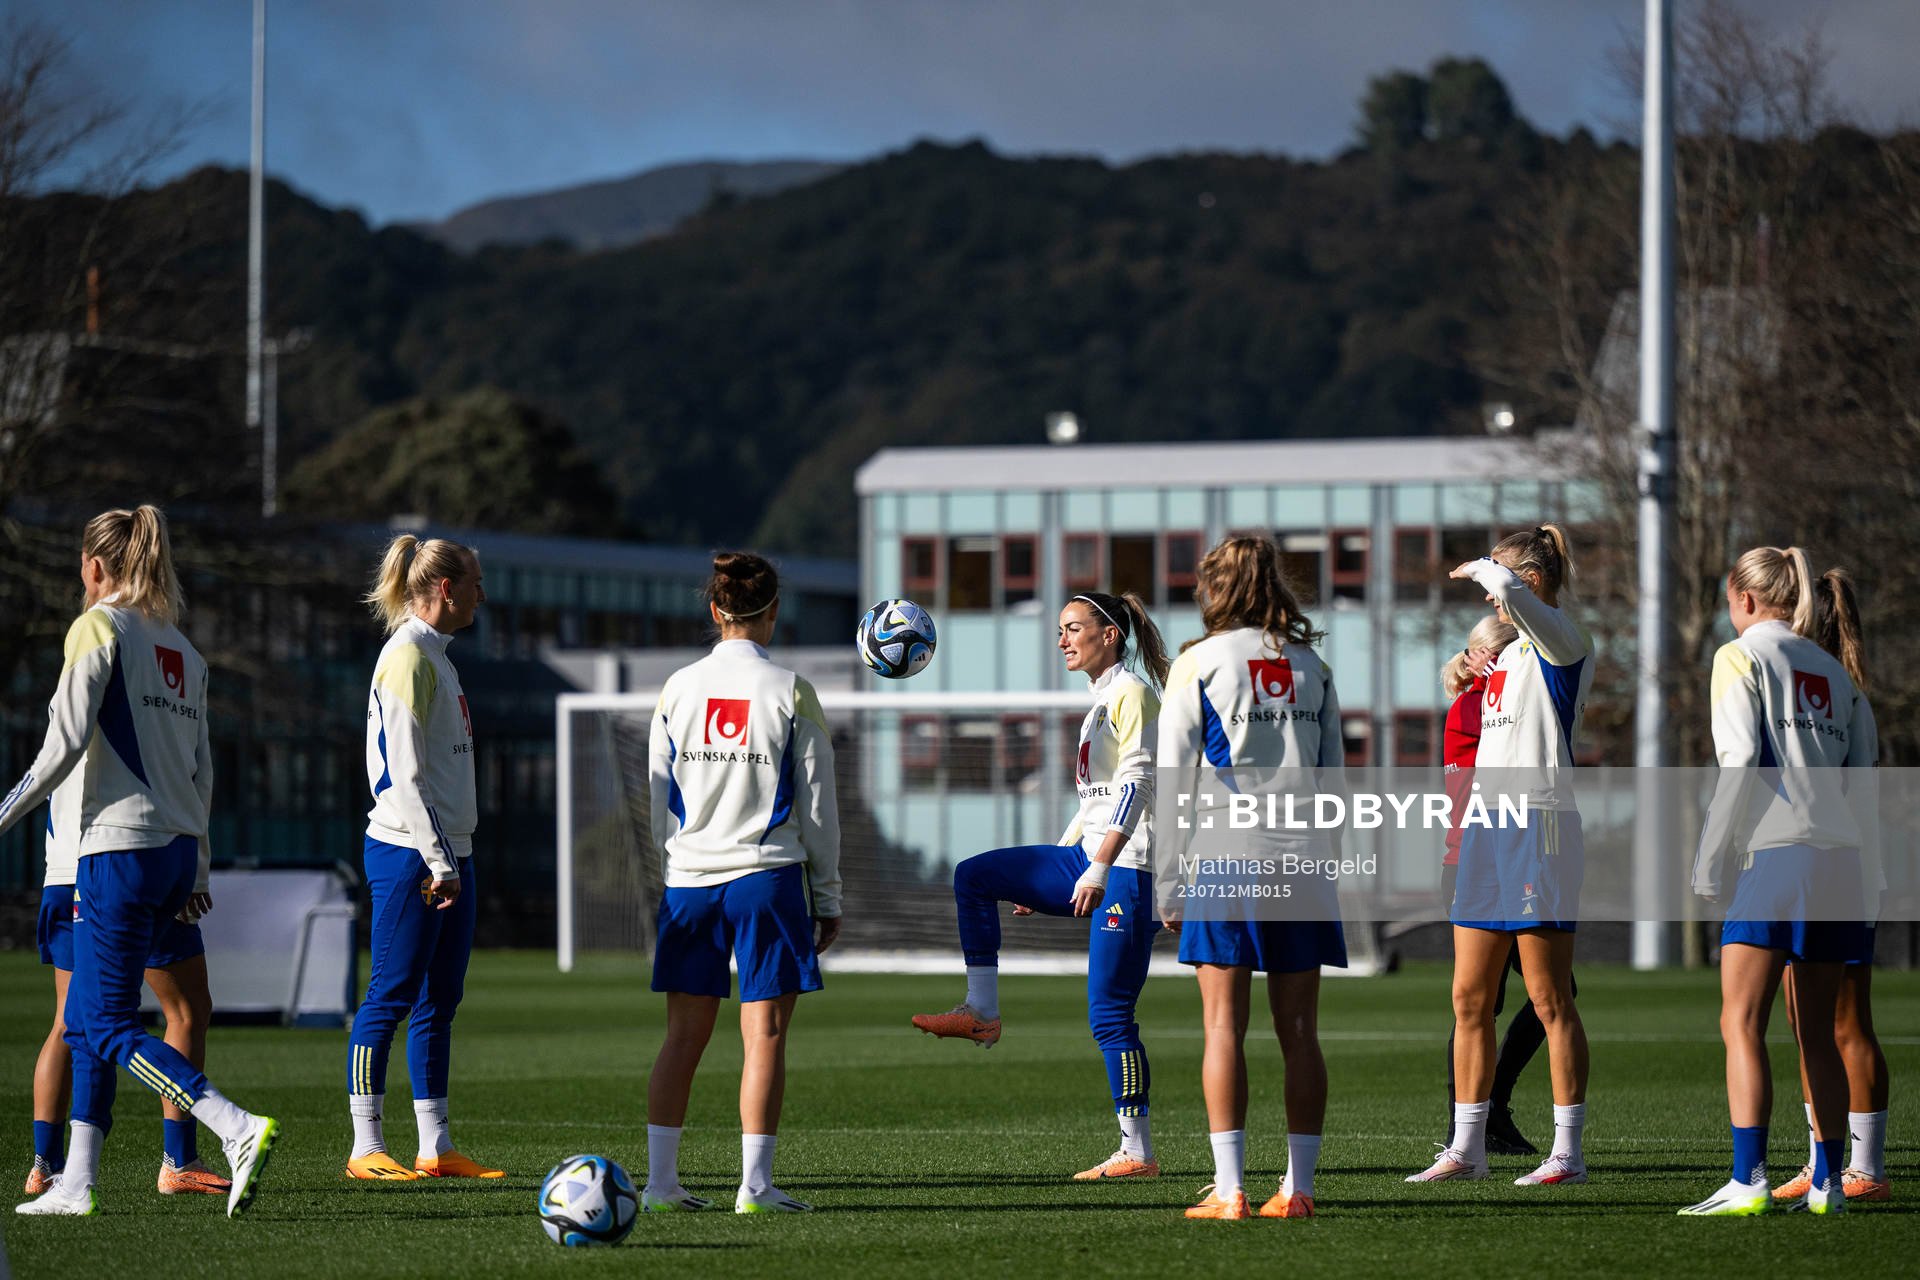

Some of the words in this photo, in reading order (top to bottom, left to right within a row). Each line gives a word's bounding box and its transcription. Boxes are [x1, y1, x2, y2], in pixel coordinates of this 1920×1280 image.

[1231, 710, 1288, 726] SVENSKA
[1291, 710, 1317, 722] SPEL
[682, 751, 737, 762] SVENSKA
[741, 752, 771, 765] SPEL
[1089, 786, 1111, 797] SPEL
